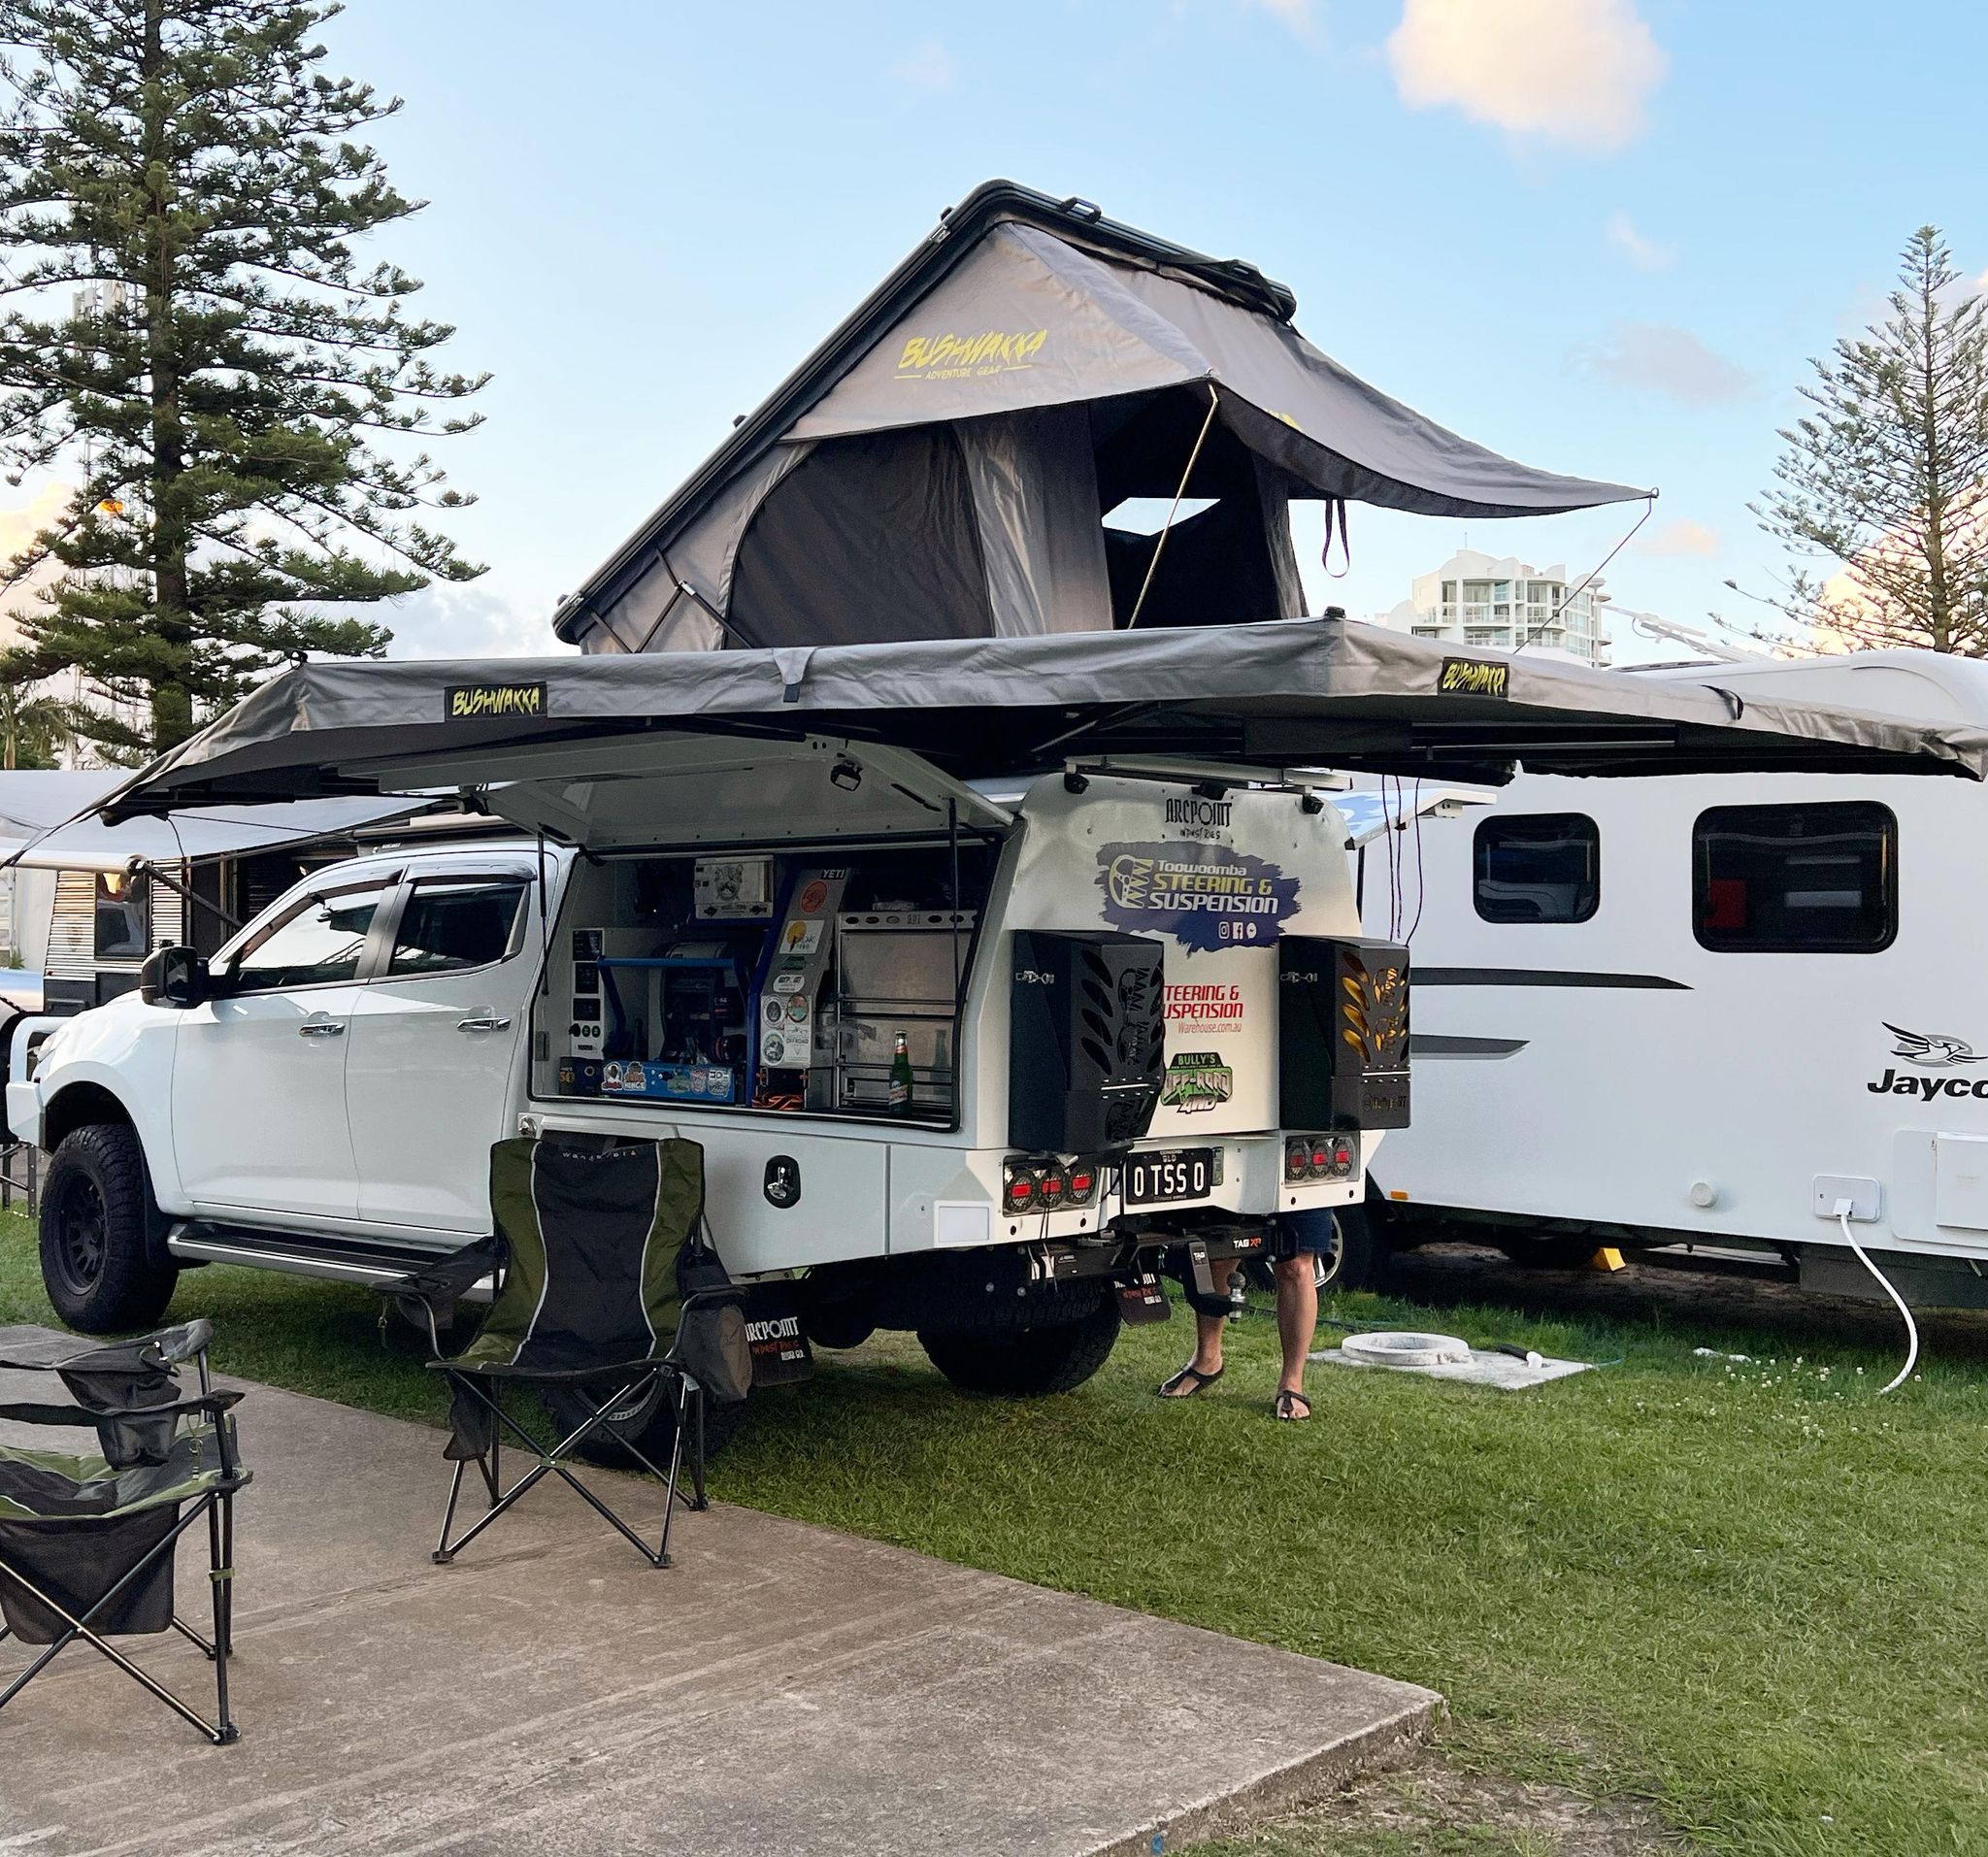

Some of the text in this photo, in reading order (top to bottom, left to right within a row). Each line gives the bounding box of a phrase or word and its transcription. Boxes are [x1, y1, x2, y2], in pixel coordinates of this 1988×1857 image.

[898, 329, 1048, 370] BUSHWAKKA
[925, 368, 972, 381] ADVENTURE
[451, 686, 540, 716] BUSHWAKKA
[1165, 798, 1233, 827] ARCPOINT
[1180, 827, 1220, 841] INDUSTRIES
[822, 869, 845, 879] YETI
[1157, 859, 1247, 876] Toowoomba
[1151, 874, 1273, 895] STEERING &
[1147, 892, 1279, 914] SUSPENSION
[1164, 985, 1240, 1001] TEERING &
[1164, 1003, 1243, 1019] USPENSION
[1177, 1022, 1242, 1034] Warehouse.com.au
[1177, 1054, 1217, 1065] BULLY'S
[1868, 1069, 1988, 1102] Jayco
[1177, 1095, 1216, 1112] 4WD
[1150, 1163, 1187, 1195] TSS
[1233, 1239, 1249, 1249] TAG
